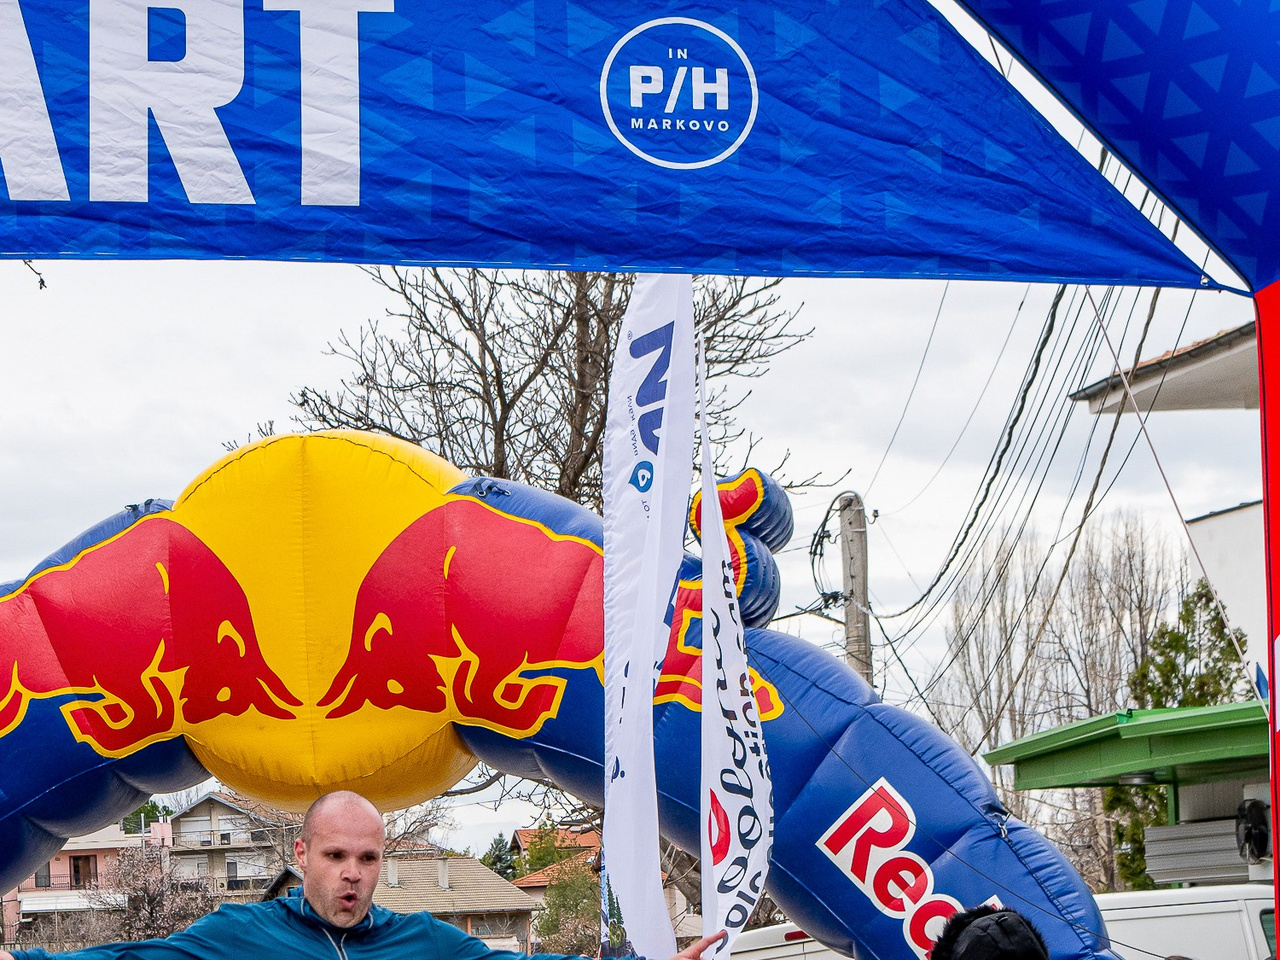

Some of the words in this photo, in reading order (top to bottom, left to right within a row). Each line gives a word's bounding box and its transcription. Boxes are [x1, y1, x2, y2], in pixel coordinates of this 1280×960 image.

[668, 48, 688, 60] IN
[629, 65, 729, 113] P/H
[631, 118, 729, 132] MARKOVO
